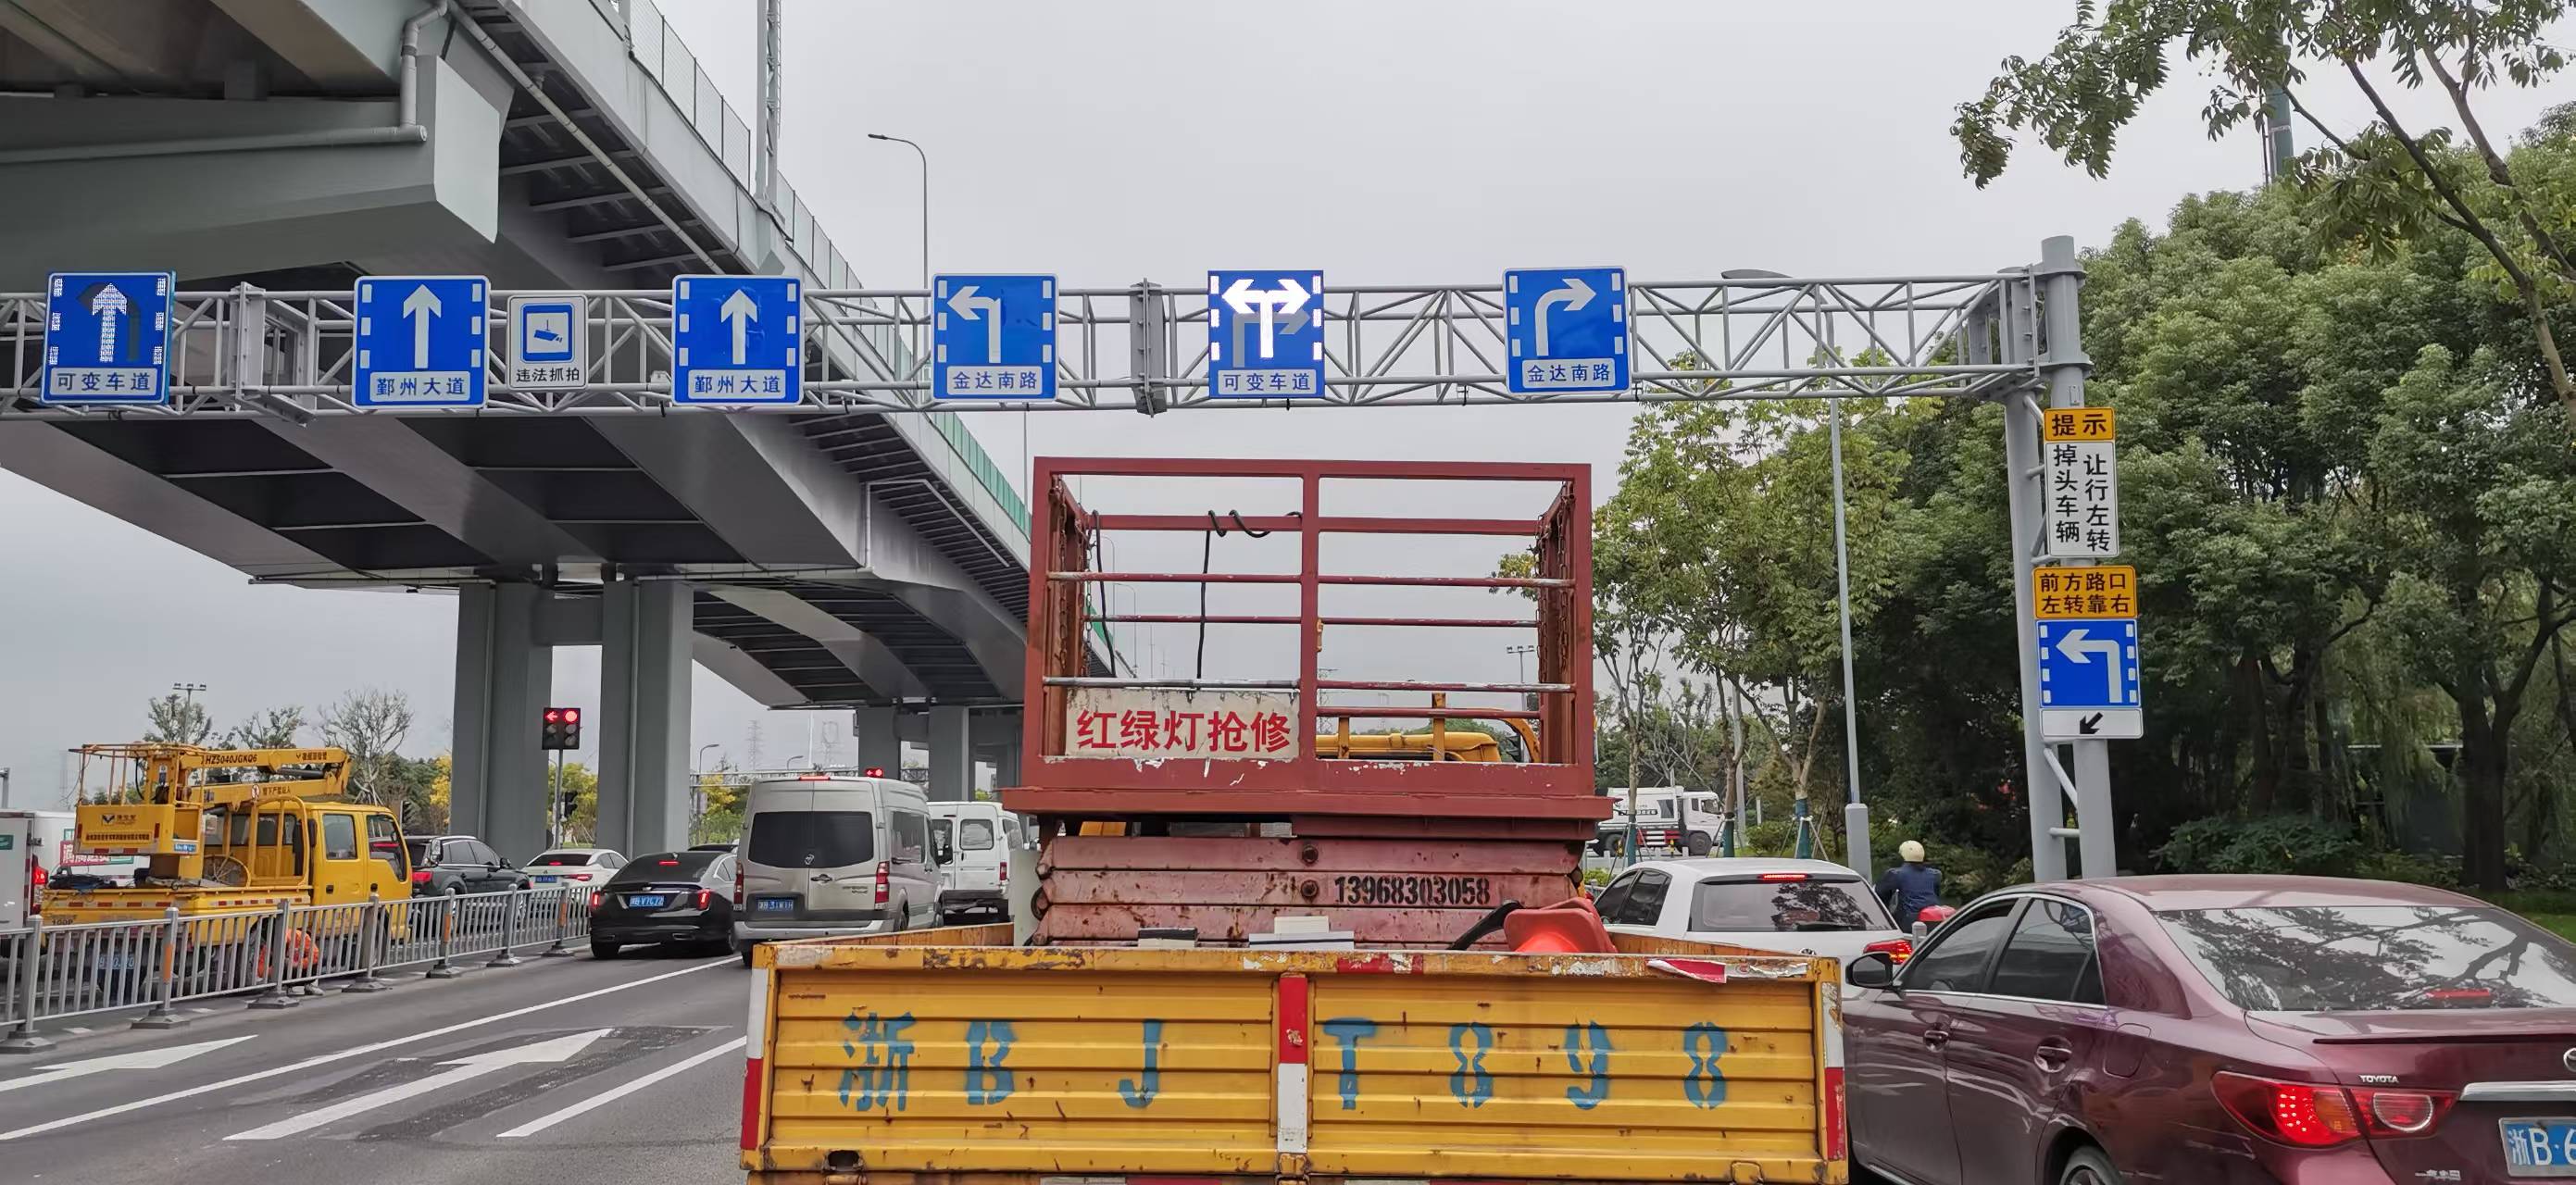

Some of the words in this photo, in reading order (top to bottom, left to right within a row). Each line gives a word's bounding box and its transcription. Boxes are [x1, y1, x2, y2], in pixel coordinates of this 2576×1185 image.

[56, 372, 150, 391] 可变车道
[516, 368, 580, 382] 违法抓拍
[953, 371, 1037, 390] 金达南路
[1222, 373, 1310, 391] 可变车道
[1527, 363, 1610, 382] 金达南路
[376, 377, 465, 396] 鄞州大道
[694, 375, 781, 393] 鄞州大道
[2052, 413, 2107, 436] 提示
[2053, 444, 2080, 543] 掉头车辆
[2083, 454, 2110, 552] 让行左转
[2040, 572, 2126, 592] 前方路口
[2042, 593, 2131, 614] 左转靠右
[1077, 709, 1291, 753] 红绿灯抢修
[1334, 876, 1490, 904] 13968303058
[2359, 1075, 2398, 1083] TOYOTA
